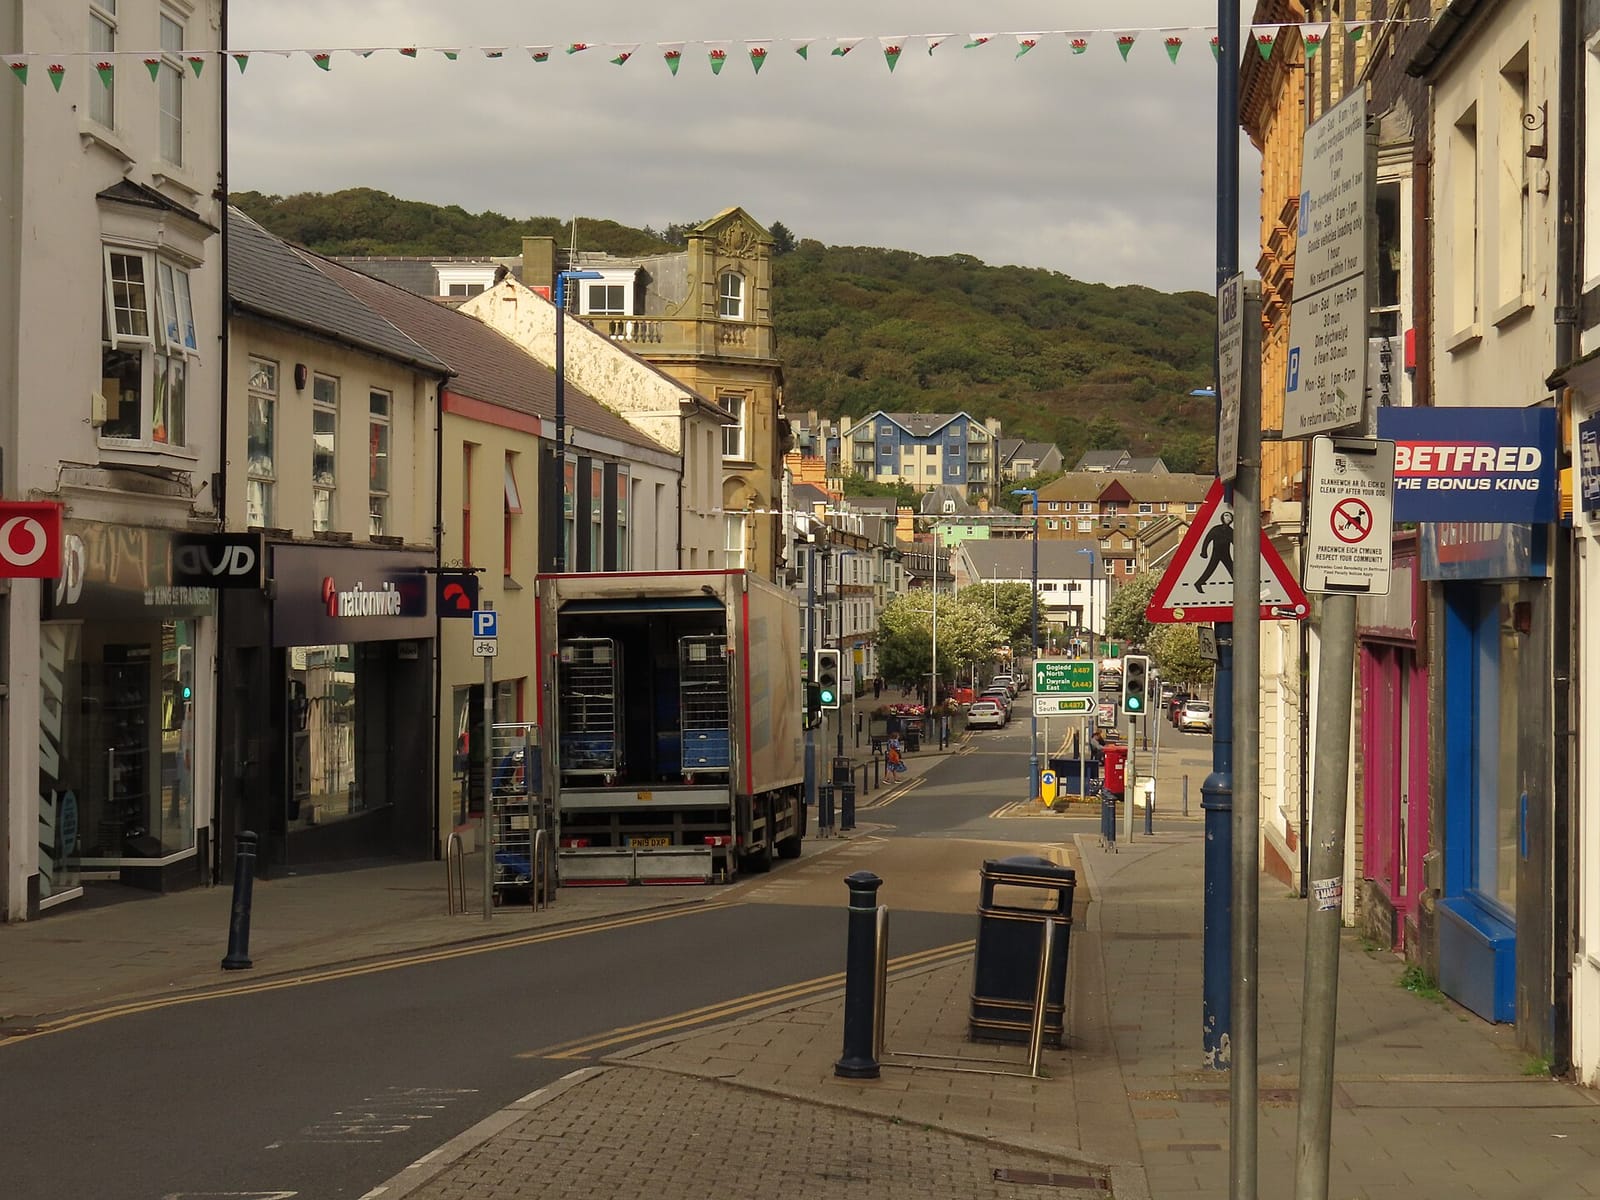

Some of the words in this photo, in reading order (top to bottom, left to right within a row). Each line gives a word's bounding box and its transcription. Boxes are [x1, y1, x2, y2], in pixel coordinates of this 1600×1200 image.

[1331, 247, 1340, 259] hour
[1317, 270, 1329, 283] return
[1348, 256, 1357, 269] hour
[1307, 413, 1321, 426] return
[1394, 446, 1542, 472] BETFRED
[1320, 486, 1336, 494] CLEAN
[1427, 478, 1491, 490] BONUS
[1495, 478, 1540, 491] KING
[1346, 546, 1358, 554] EICH
[212, 545, 255, 576] JD
[338, 581, 400, 617] nationwide
[479, 613, 494, 635] P
[1046, 664, 1072, 672] Gogledd
[651, 839, 667, 848] DXP
